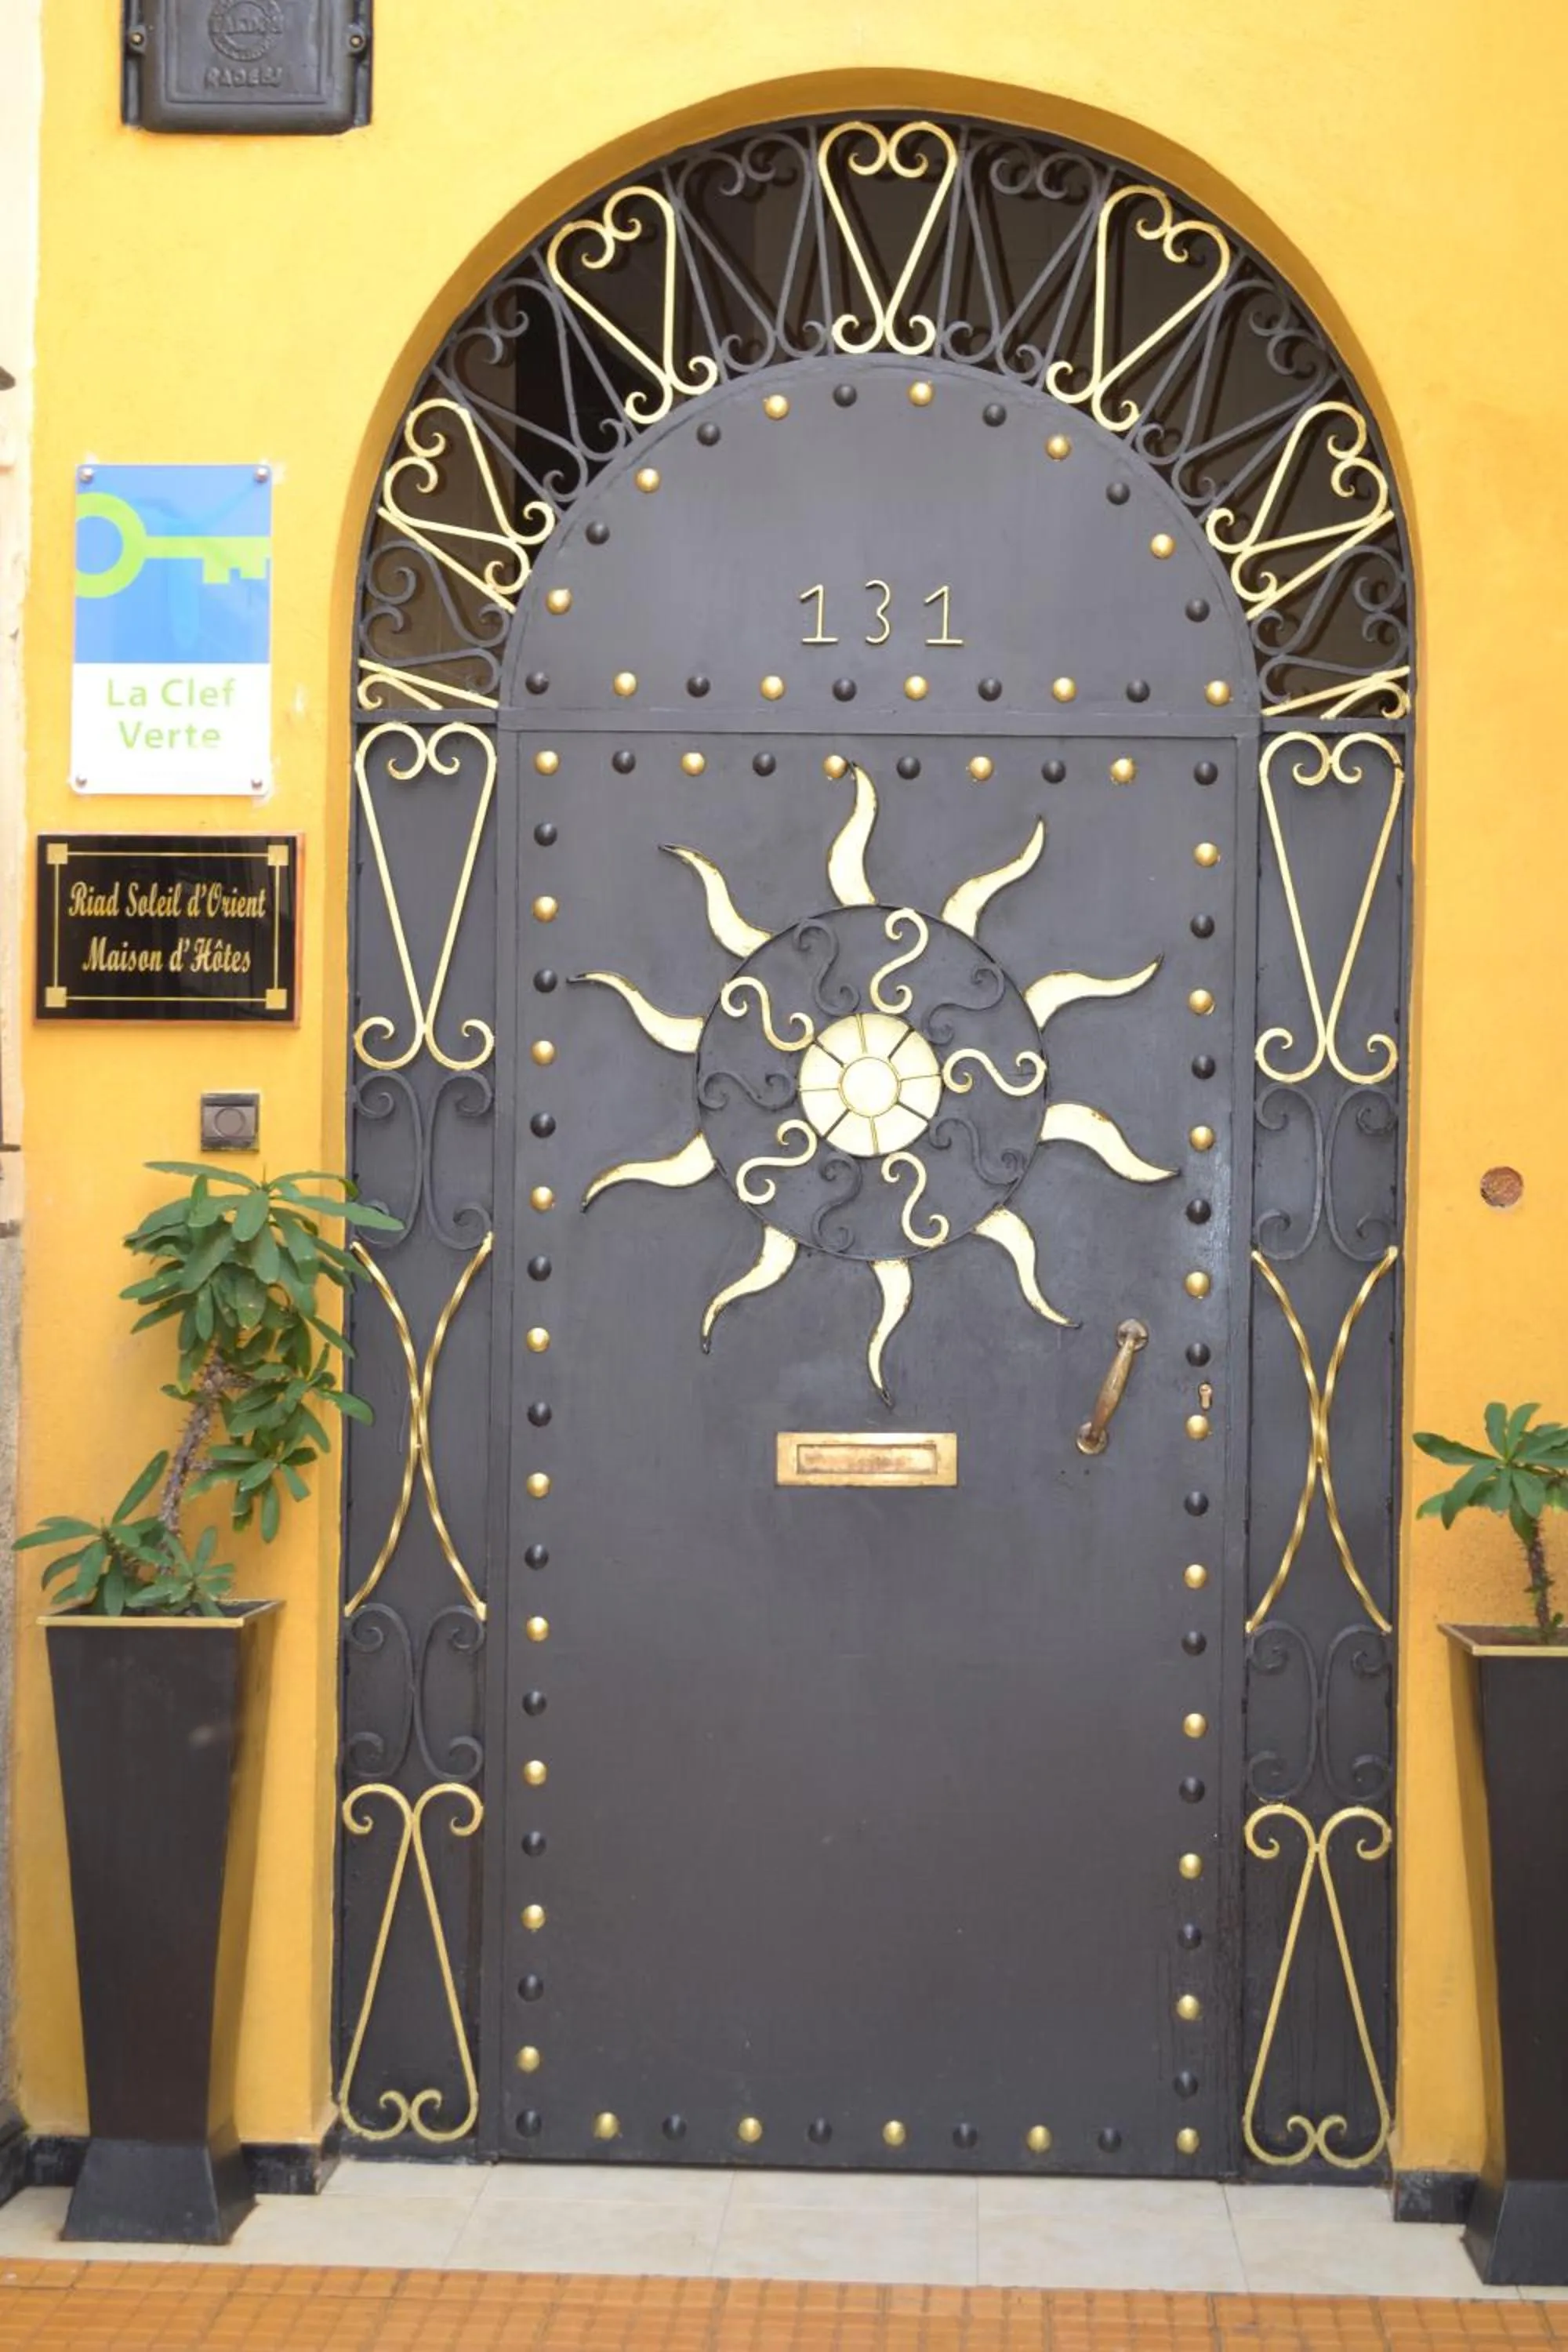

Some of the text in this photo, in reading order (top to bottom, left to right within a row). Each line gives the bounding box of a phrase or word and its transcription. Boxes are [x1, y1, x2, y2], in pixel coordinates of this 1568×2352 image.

[800, 579, 964, 645] 131
[107, 677, 235, 706] La Clef
[118, 720, 221, 749] Verte
[68, 881, 266, 917] Riad Soleil d'Orient
[82, 937, 162, 971] Maison
